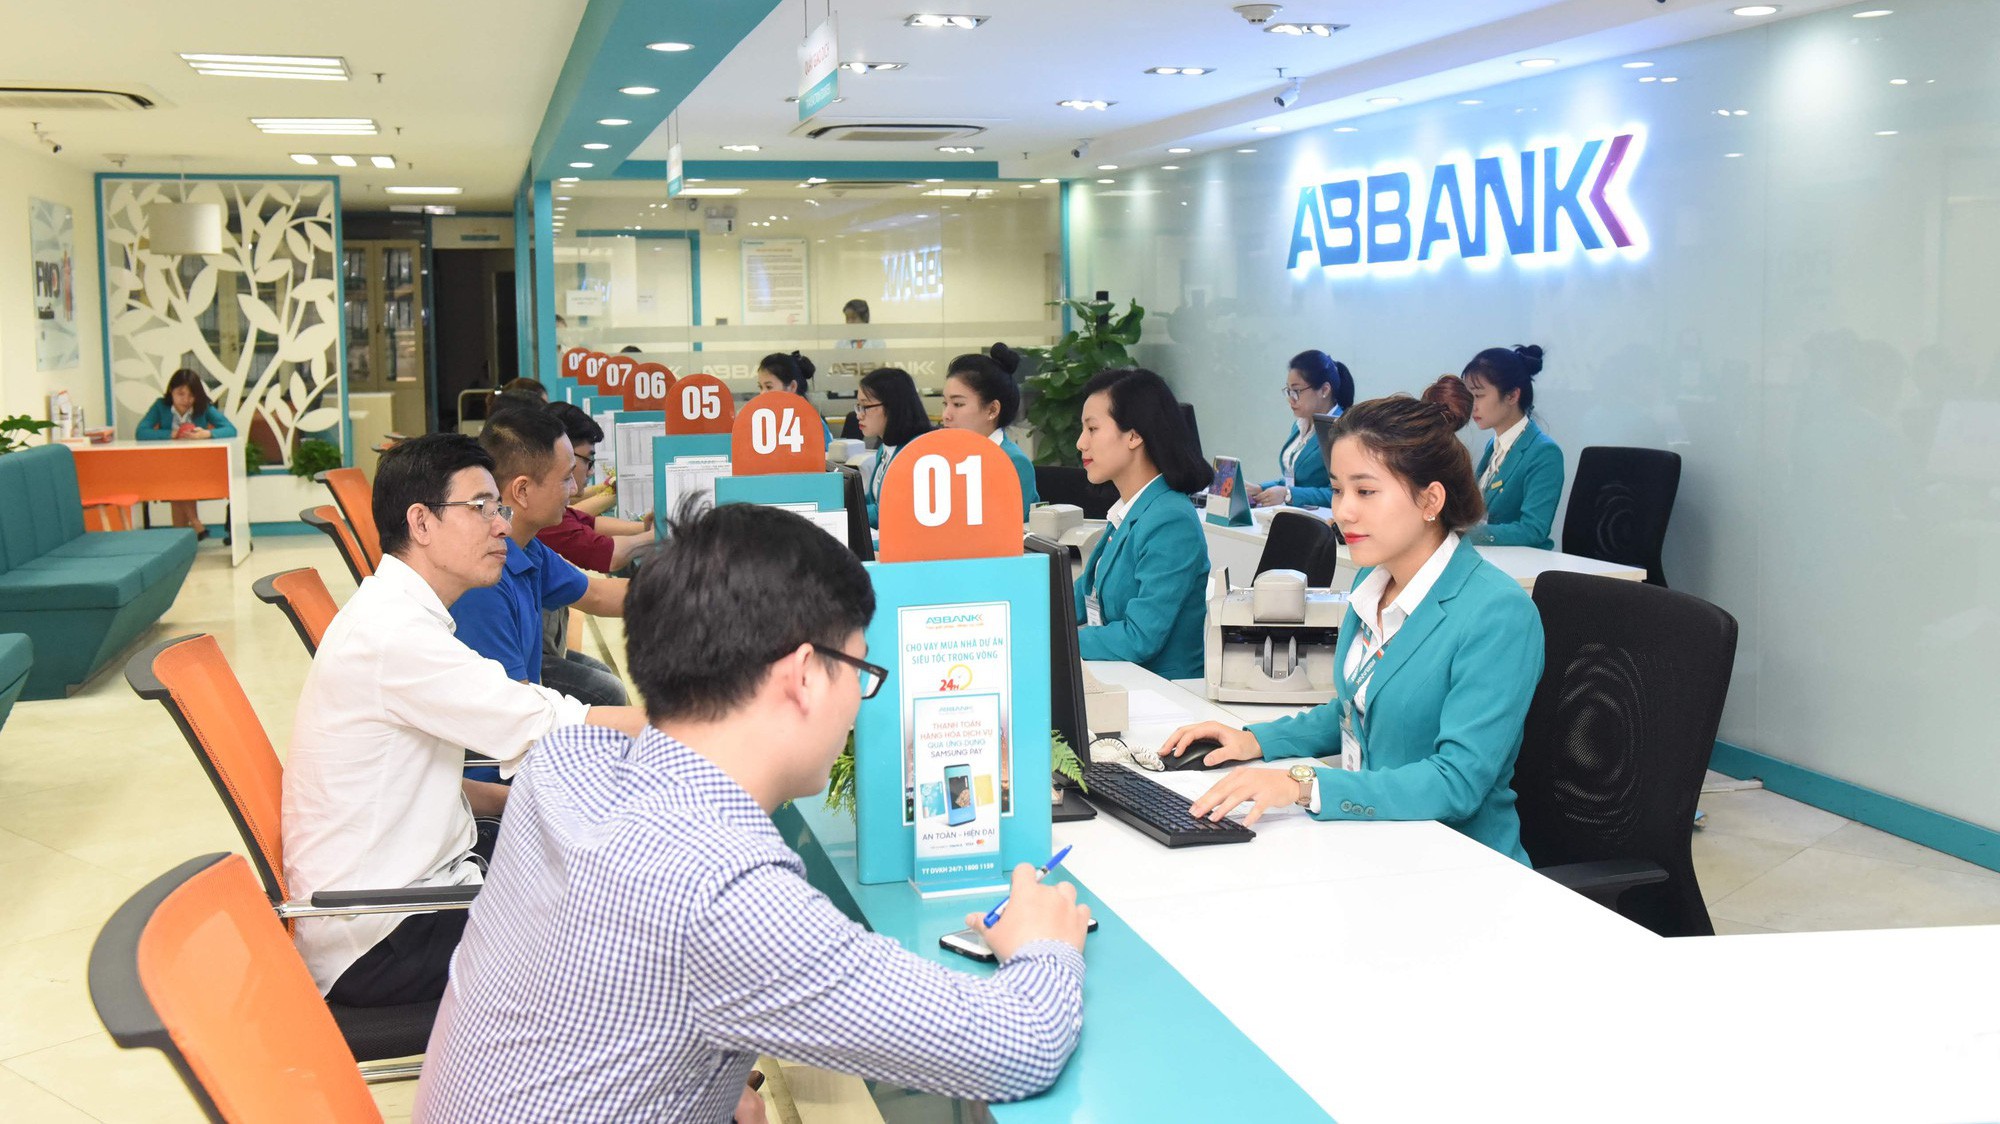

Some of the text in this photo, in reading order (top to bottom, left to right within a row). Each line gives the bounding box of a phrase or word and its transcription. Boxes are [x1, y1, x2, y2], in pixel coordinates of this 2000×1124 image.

[1287, 134, 1634, 270] ABBANK
[606, 363, 632, 387] 07
[634, 371, 666, 400] 06
[682, 385, 721, 420] 05
[751, 407, 804, 455] 04
[913, 454, 983, 527] 01
[926, 614, 983, 624] ABBANK
[905, 642, 922, 652] CHO
[923, 642, 938, 651] VAY
[940, 640, 958, 650] MUA
[948, 652, 975, 662] TRONG
[930, 749, 968, 758] SAMSUNG
[922, 867, 929, 875] TT
